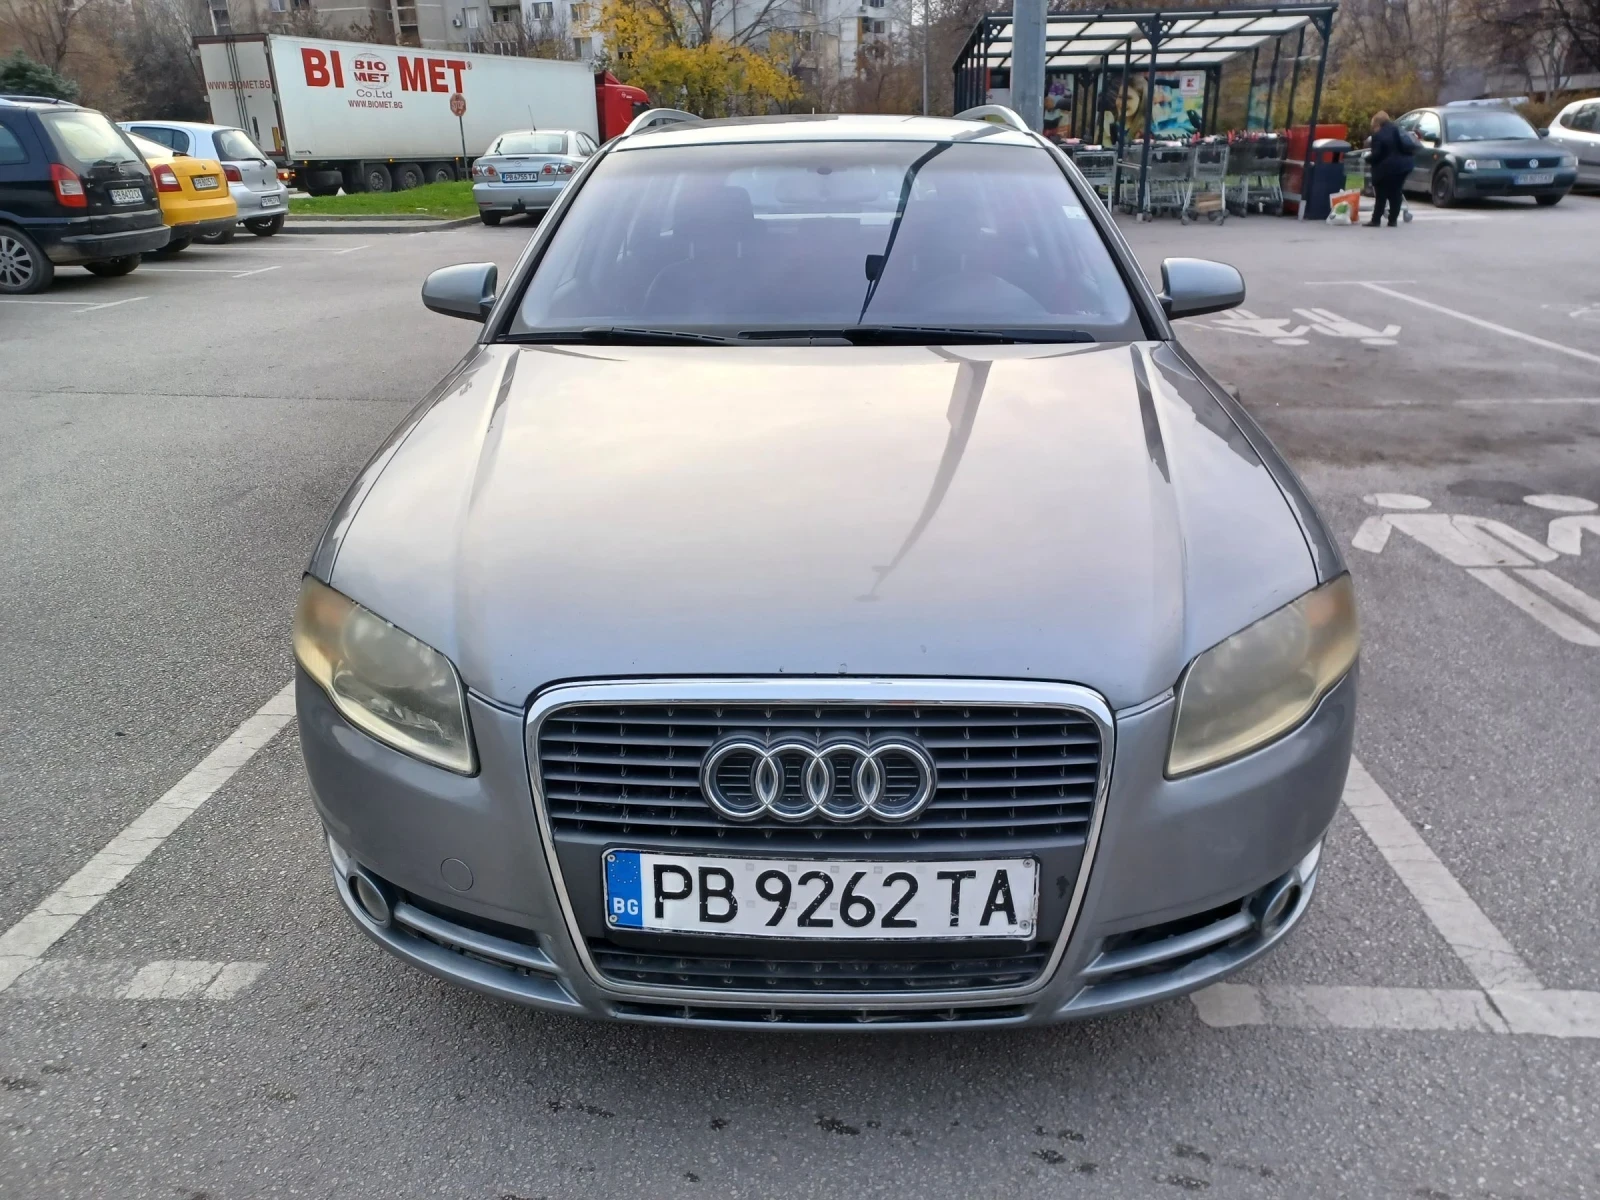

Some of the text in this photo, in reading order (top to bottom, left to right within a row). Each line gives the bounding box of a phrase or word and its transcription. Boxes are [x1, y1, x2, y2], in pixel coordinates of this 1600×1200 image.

[300, 47, 466, 94] BI MET
[354, 60, 387, 71] BIO
[353, 72, 389, 83] MET
[206, 80, 271, 90] WWW.BIOMET.BG
[356, 89, 393, 99] Co.Ltd
[348, 100, 403, 109] WWW.BIOMET.BG
[653, 864, 1017, 928] PB 9262 TA
[612, 897, 639, 916] BG
